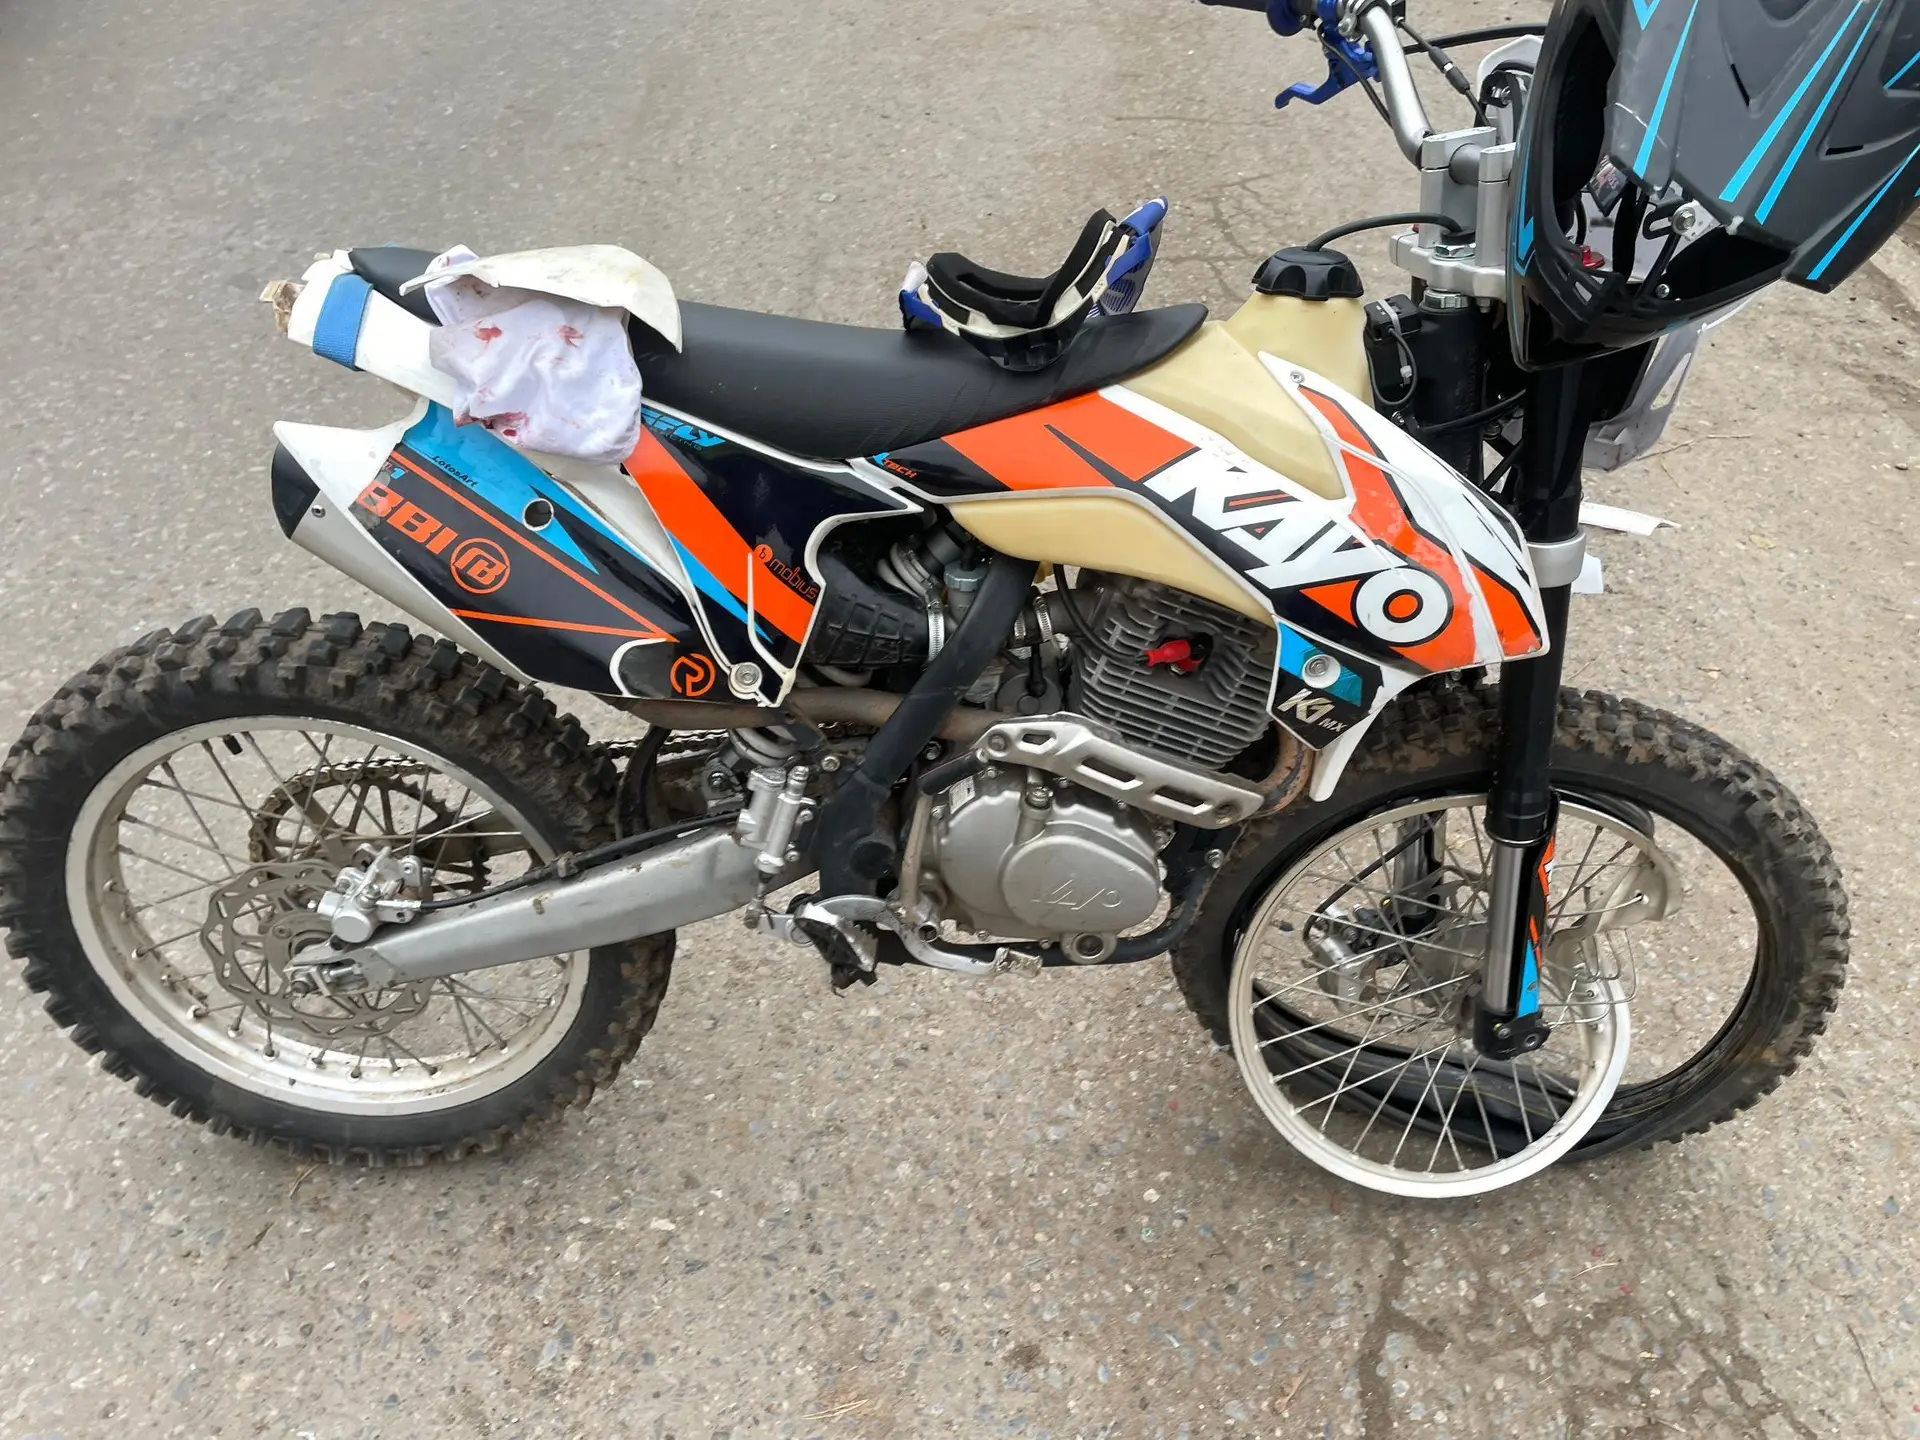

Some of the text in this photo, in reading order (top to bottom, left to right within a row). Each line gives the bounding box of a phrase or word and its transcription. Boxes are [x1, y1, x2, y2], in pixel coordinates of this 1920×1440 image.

[1142, 448, 1453, 646] KAYO
[769, 558, 819, 599] mobius
[1318, 718, 1348, 732] MX
